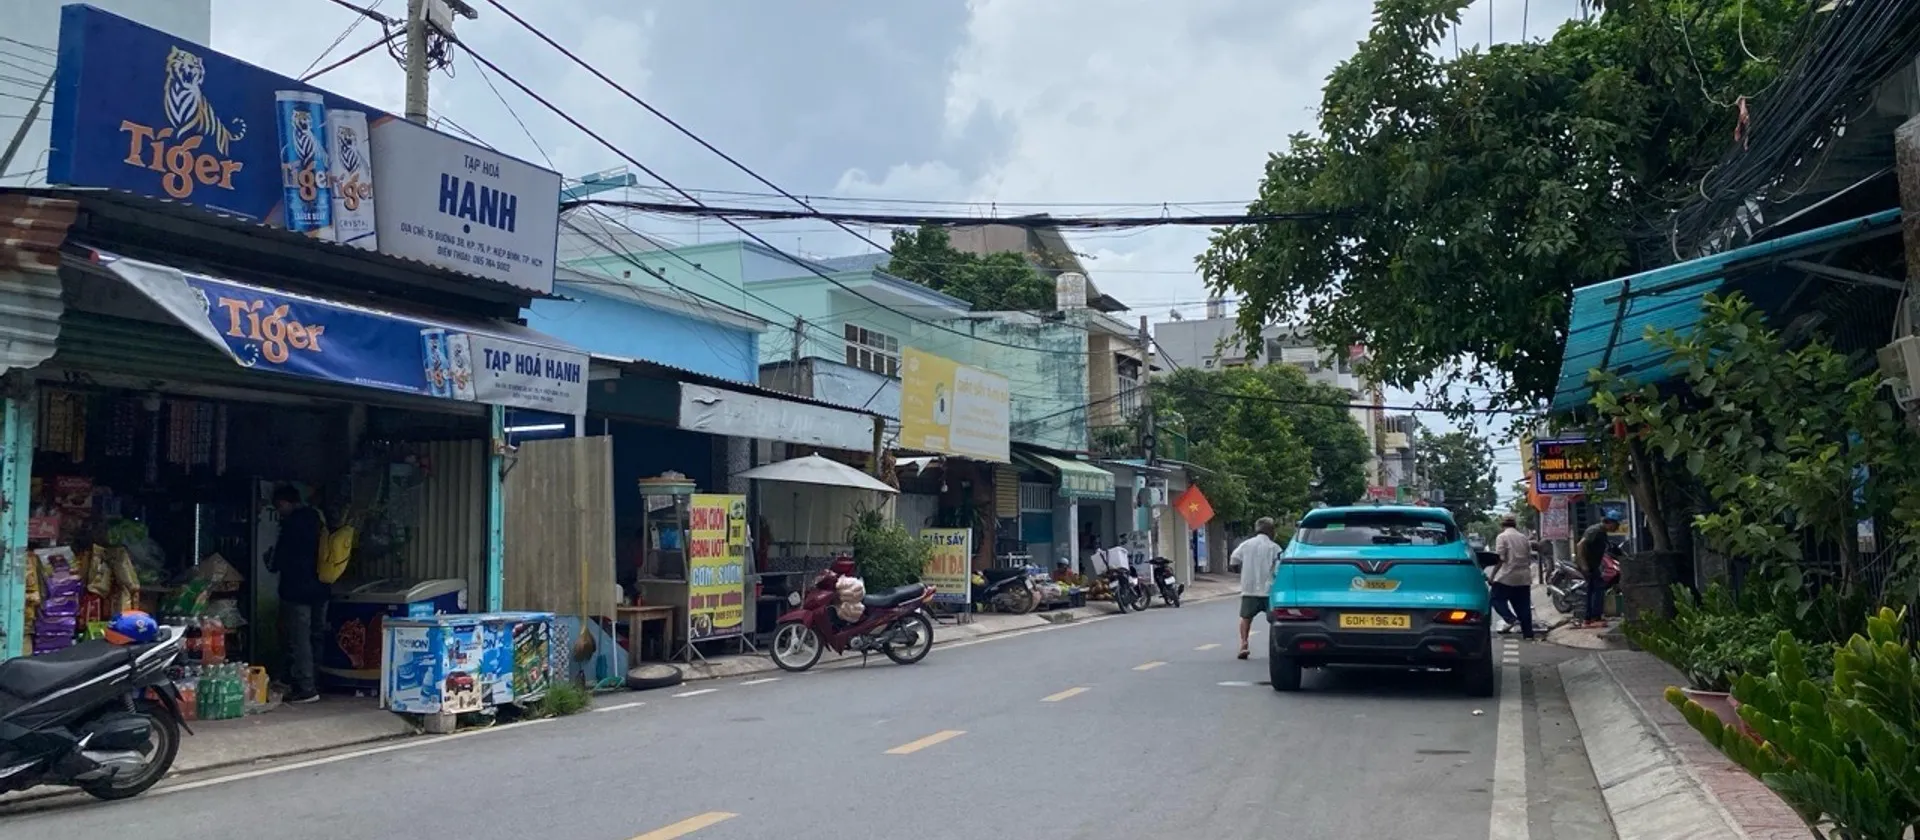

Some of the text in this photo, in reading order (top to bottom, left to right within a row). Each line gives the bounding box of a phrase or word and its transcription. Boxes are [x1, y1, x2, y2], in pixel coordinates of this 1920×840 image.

[120, 119, 243, 198] Tiger
[464, 154, 500, 179] TẠP HOÁ
[439, 172, 517, 234] HẠNH
[219, 297, 325, 364] Tiger
[484, 348, 580, 387] TẠP HOÁ HẠNH
[946, 531, 965, 546] SẤY
